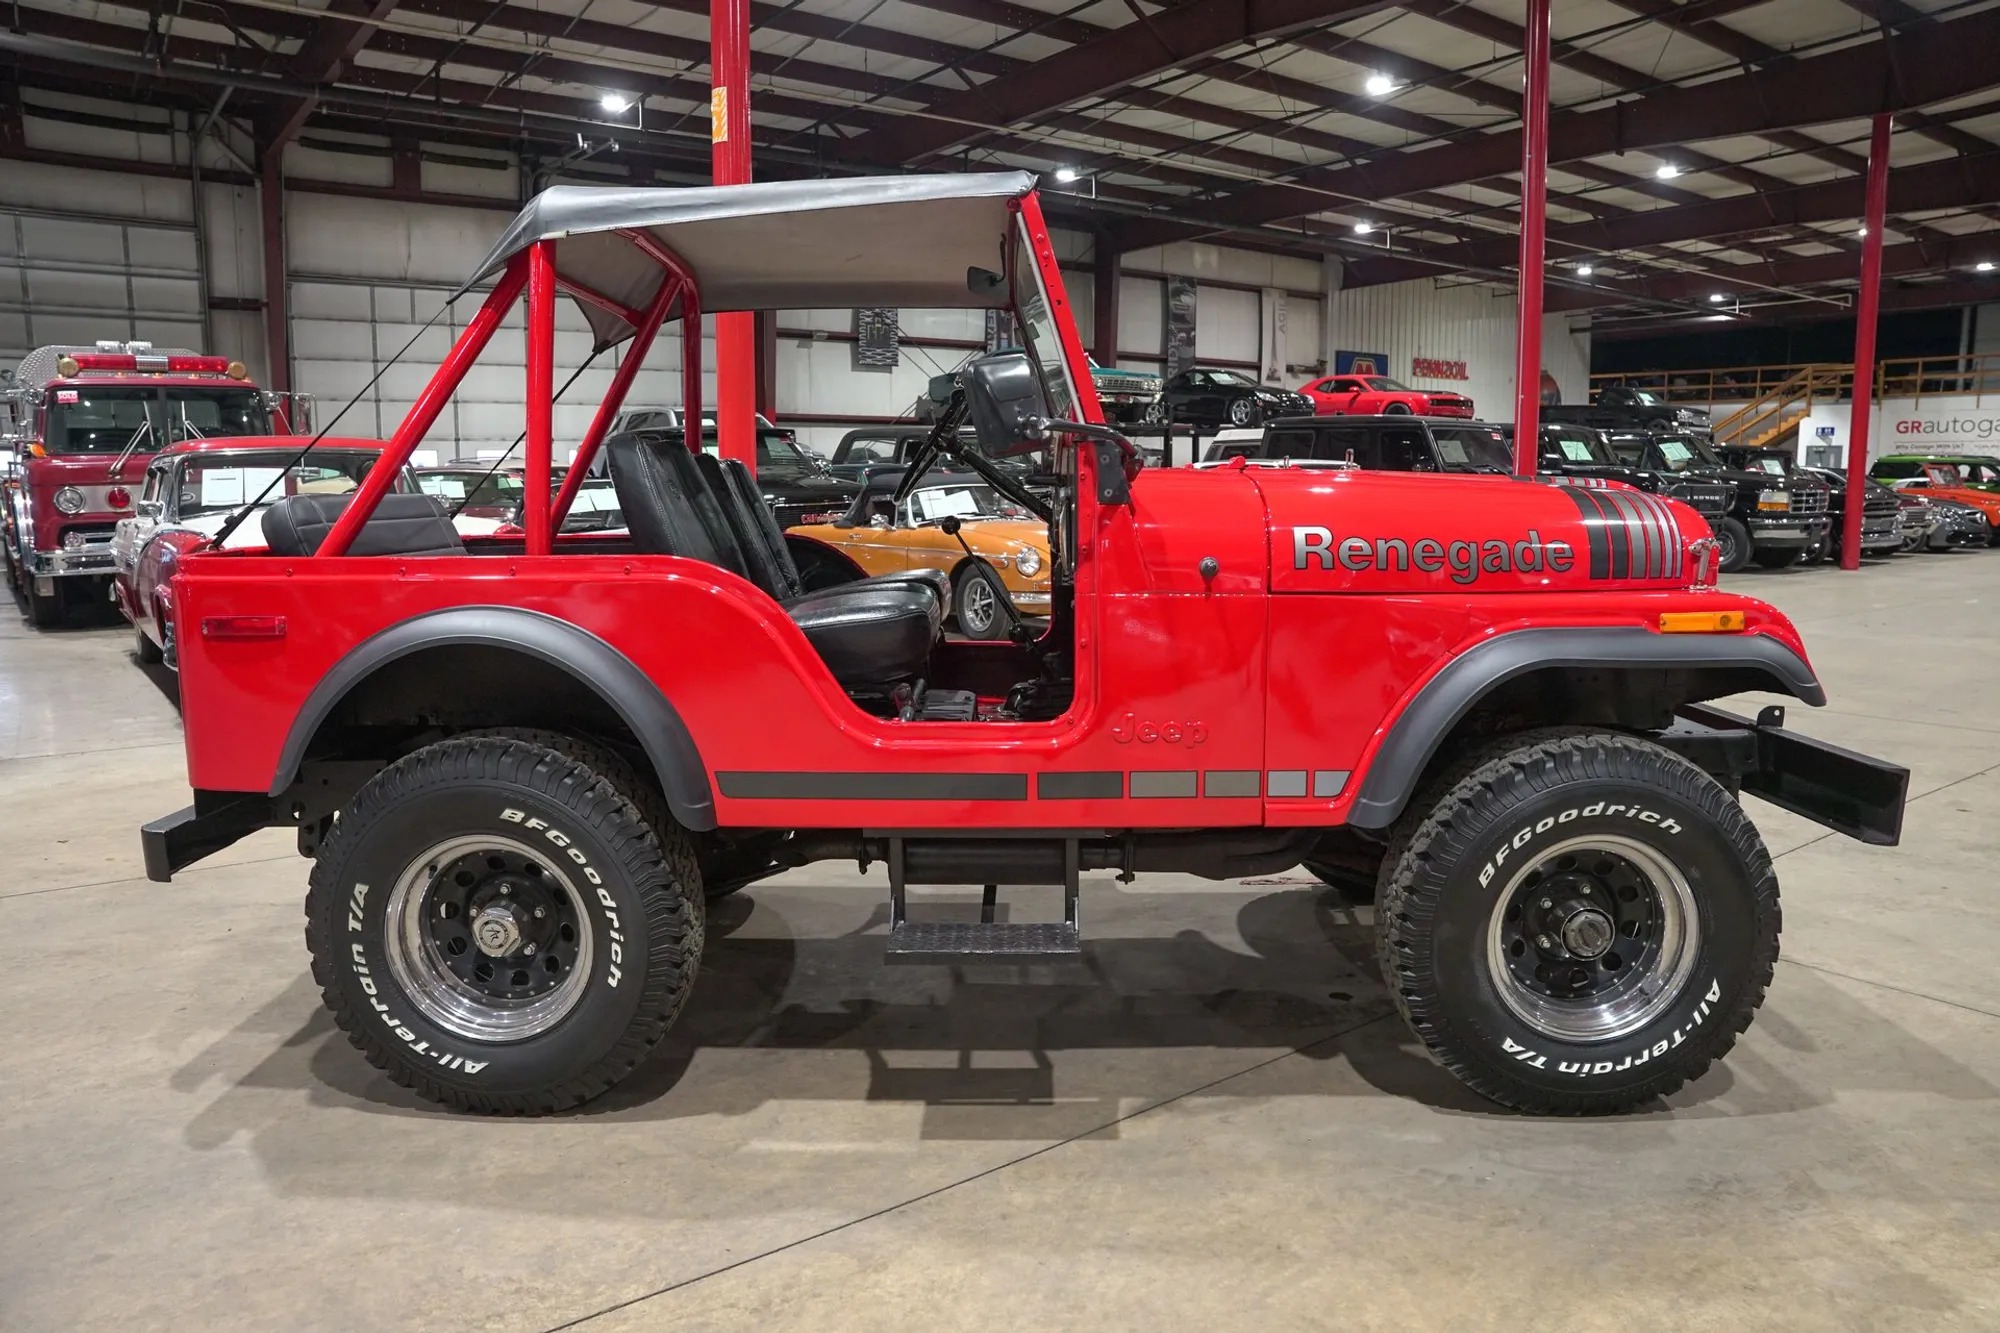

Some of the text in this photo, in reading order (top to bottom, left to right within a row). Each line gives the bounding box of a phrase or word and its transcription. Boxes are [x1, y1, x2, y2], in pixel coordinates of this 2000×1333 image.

[1412, 357, 1469, 380] PENNZOIL
[1292, 525, 1575, 585] Renegade
[1111, 711, 1209, 749] Jeep
[1478, 801, 1683, 889] BFGoodrich
[499, 807, 623, 988] BFGoodrich
[348, 883, 490, 1075] All-Terrain T/A
[1501, 977, 1721, 1078] All-Terrain T/A
